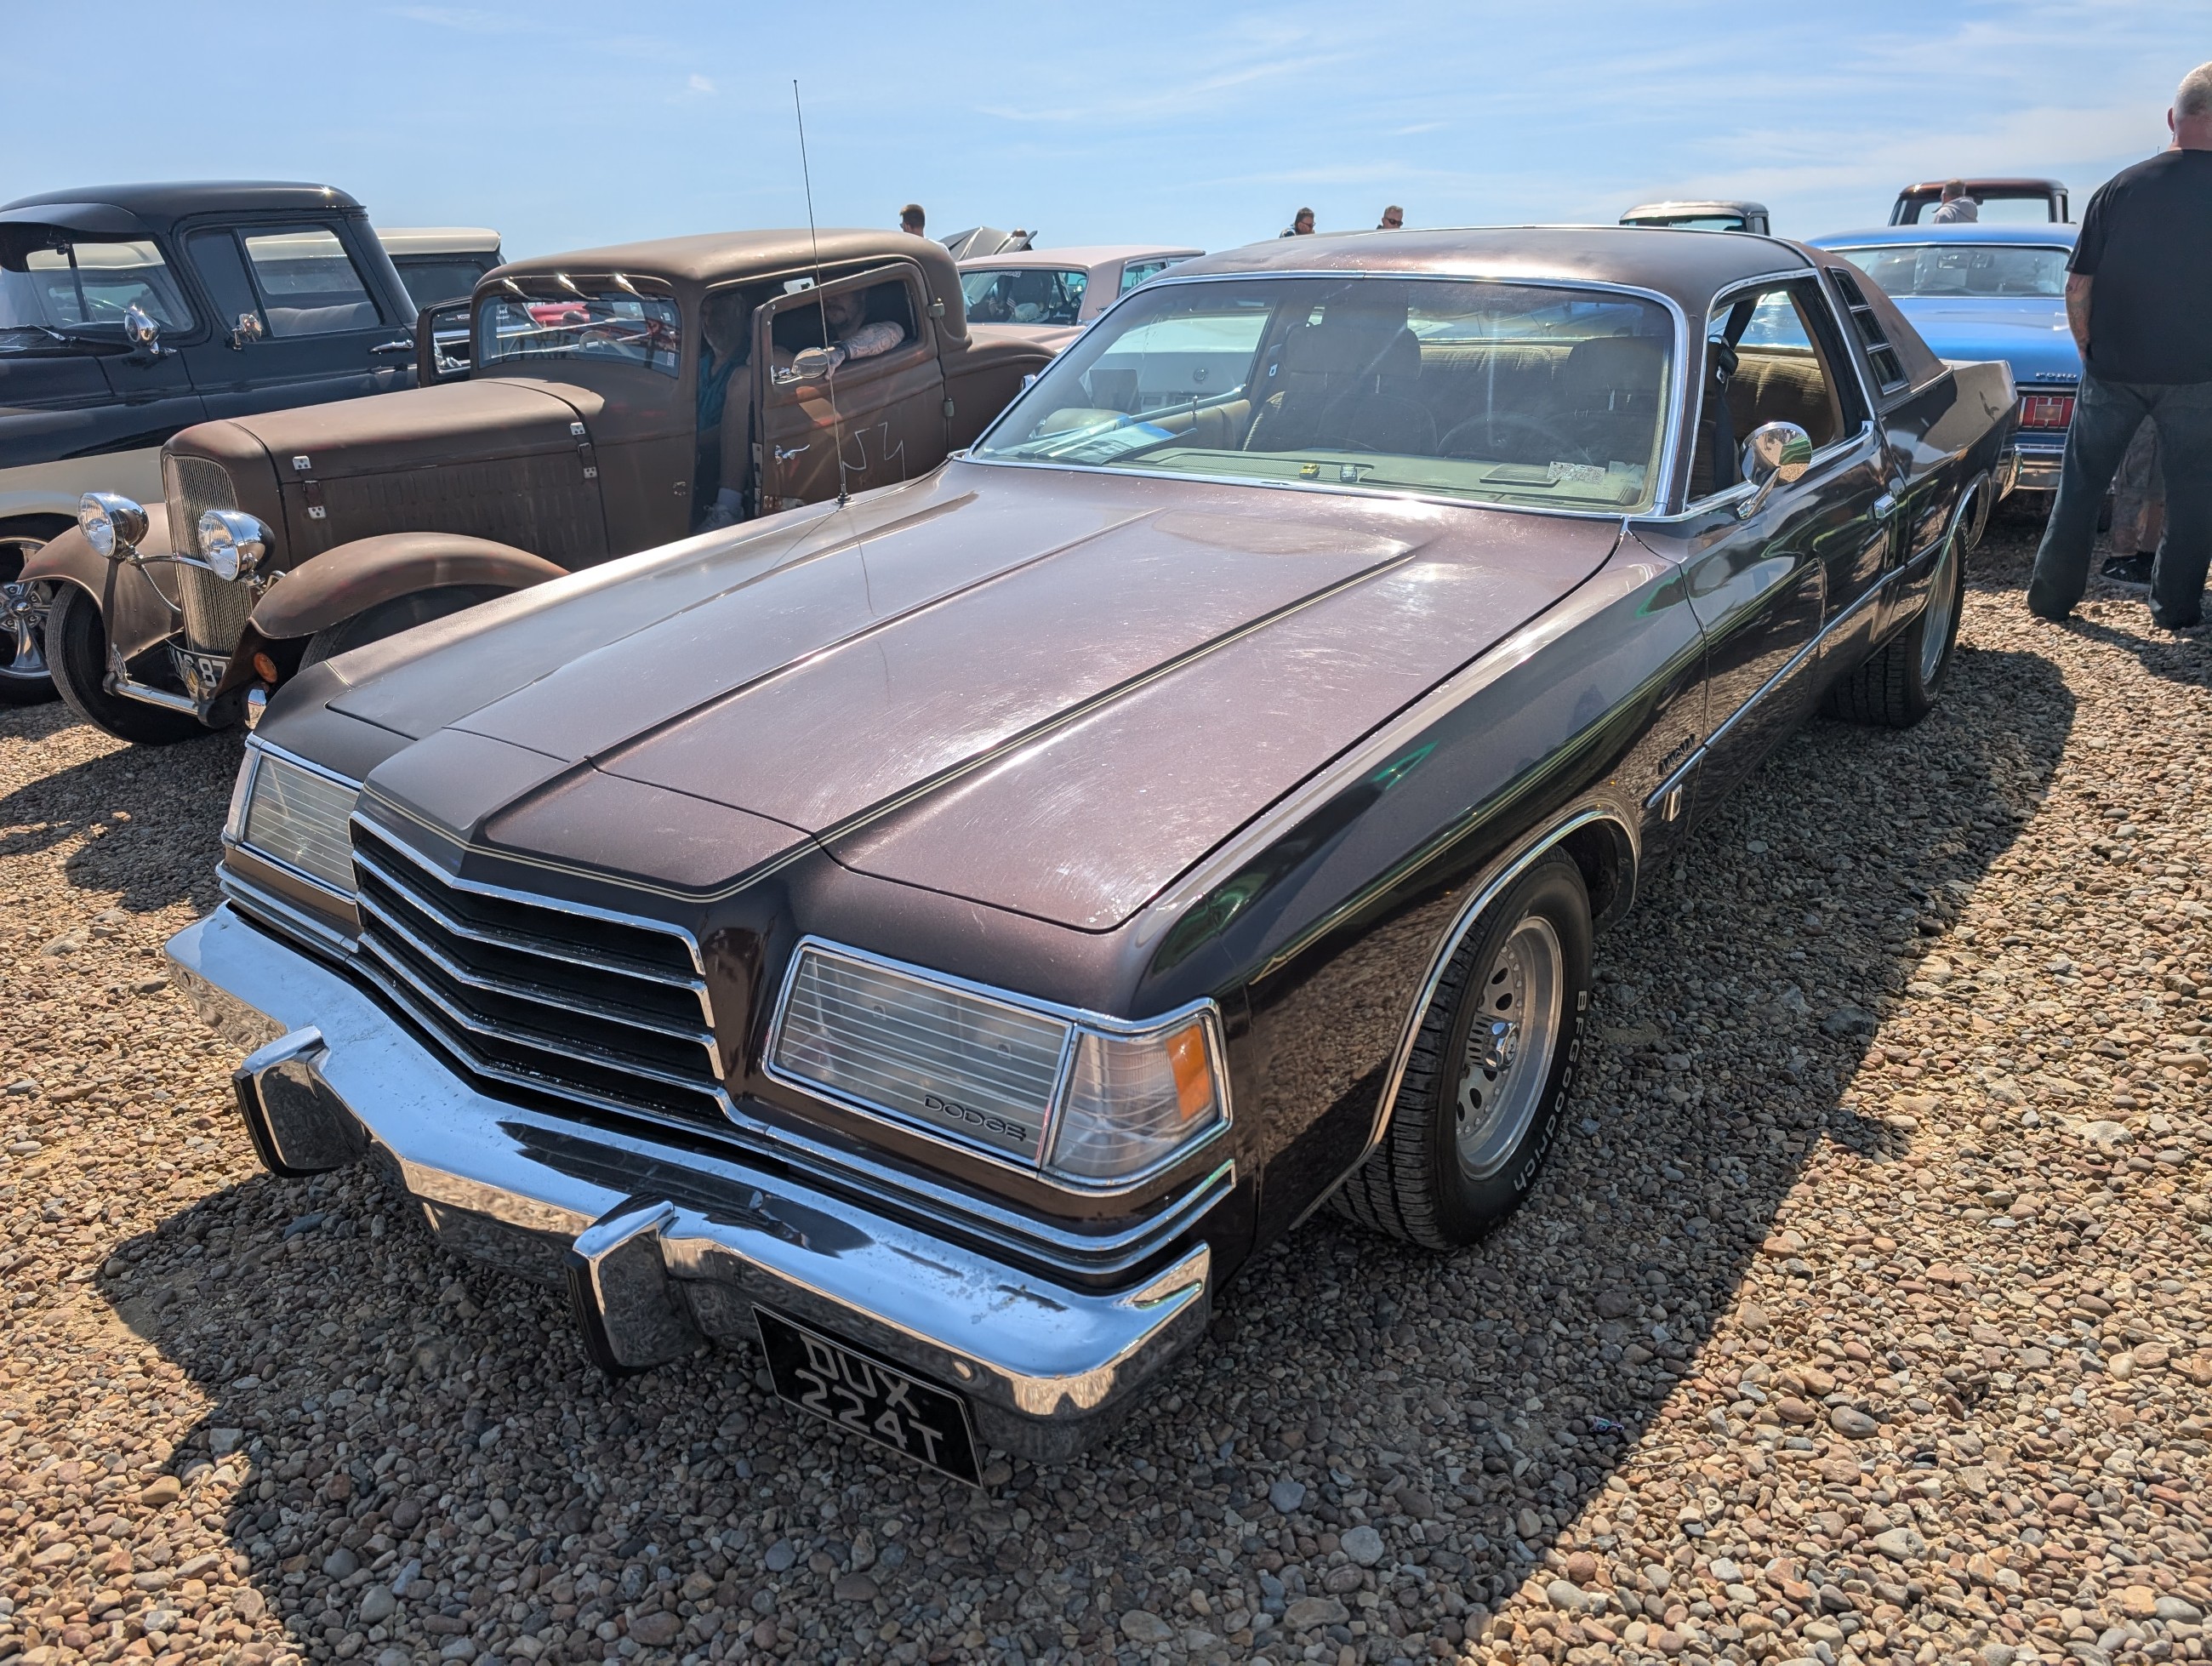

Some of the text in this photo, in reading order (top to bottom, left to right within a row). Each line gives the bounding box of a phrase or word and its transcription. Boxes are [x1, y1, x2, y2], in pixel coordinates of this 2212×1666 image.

[924, 1094, 1026, 1142] DODGE
[795, 1367, 943, 1464] 224T
[800, 1332, 920, 1418] DUX
